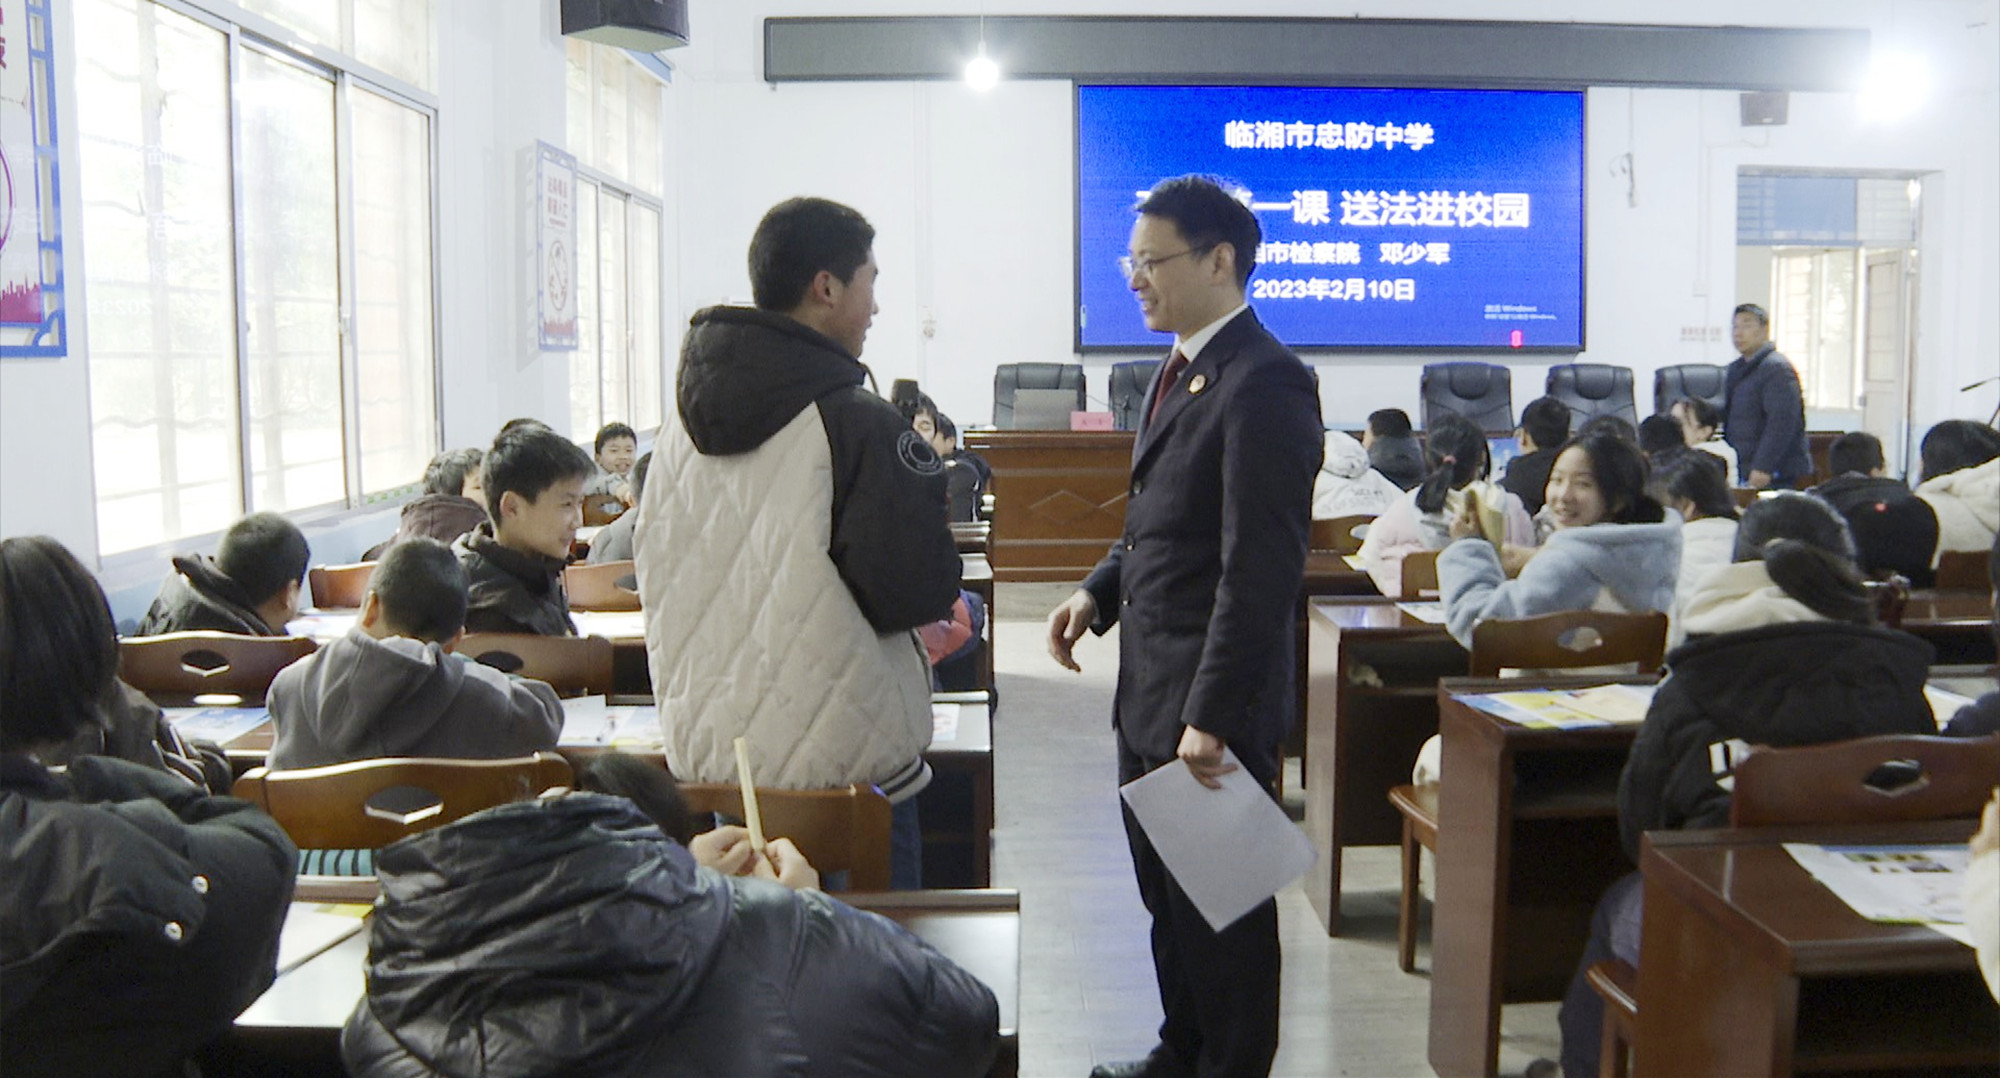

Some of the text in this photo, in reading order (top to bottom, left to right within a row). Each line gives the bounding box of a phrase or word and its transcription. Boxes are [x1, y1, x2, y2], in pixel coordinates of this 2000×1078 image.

[1224, 120, 1435, 151] 临湘市忠防中学
[1339, 189, 1531, 229] 送法进校园
[1378, 241, 1451, 266] 邓少军
[1252, 277, 1416, 302] 2023年2月10日
